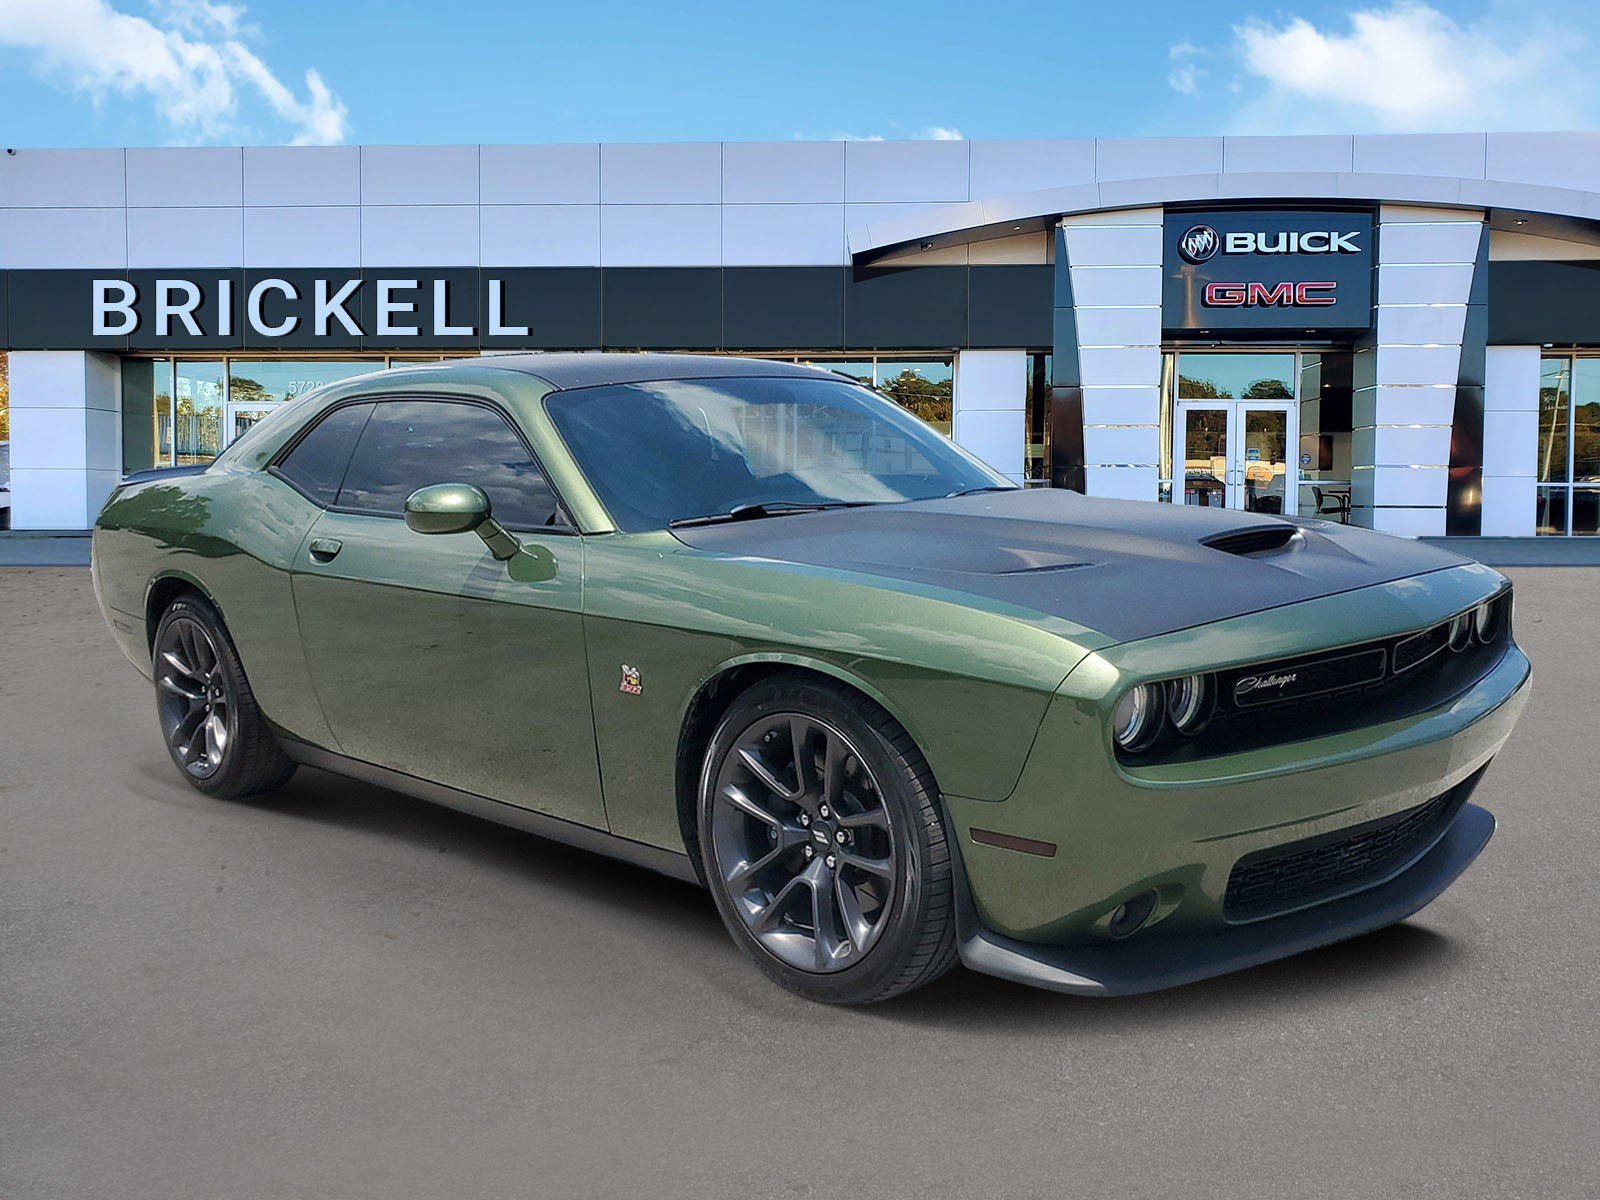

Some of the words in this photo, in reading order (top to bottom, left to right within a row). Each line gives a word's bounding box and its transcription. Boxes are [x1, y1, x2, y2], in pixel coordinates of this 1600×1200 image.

[1225, 231, 1362, 253] BUICK
[1205, 281, 1337, 305] GMC
[91, 278, 531, 337] BRICKELL
[1235, 673, 1297, 694] Challenger
